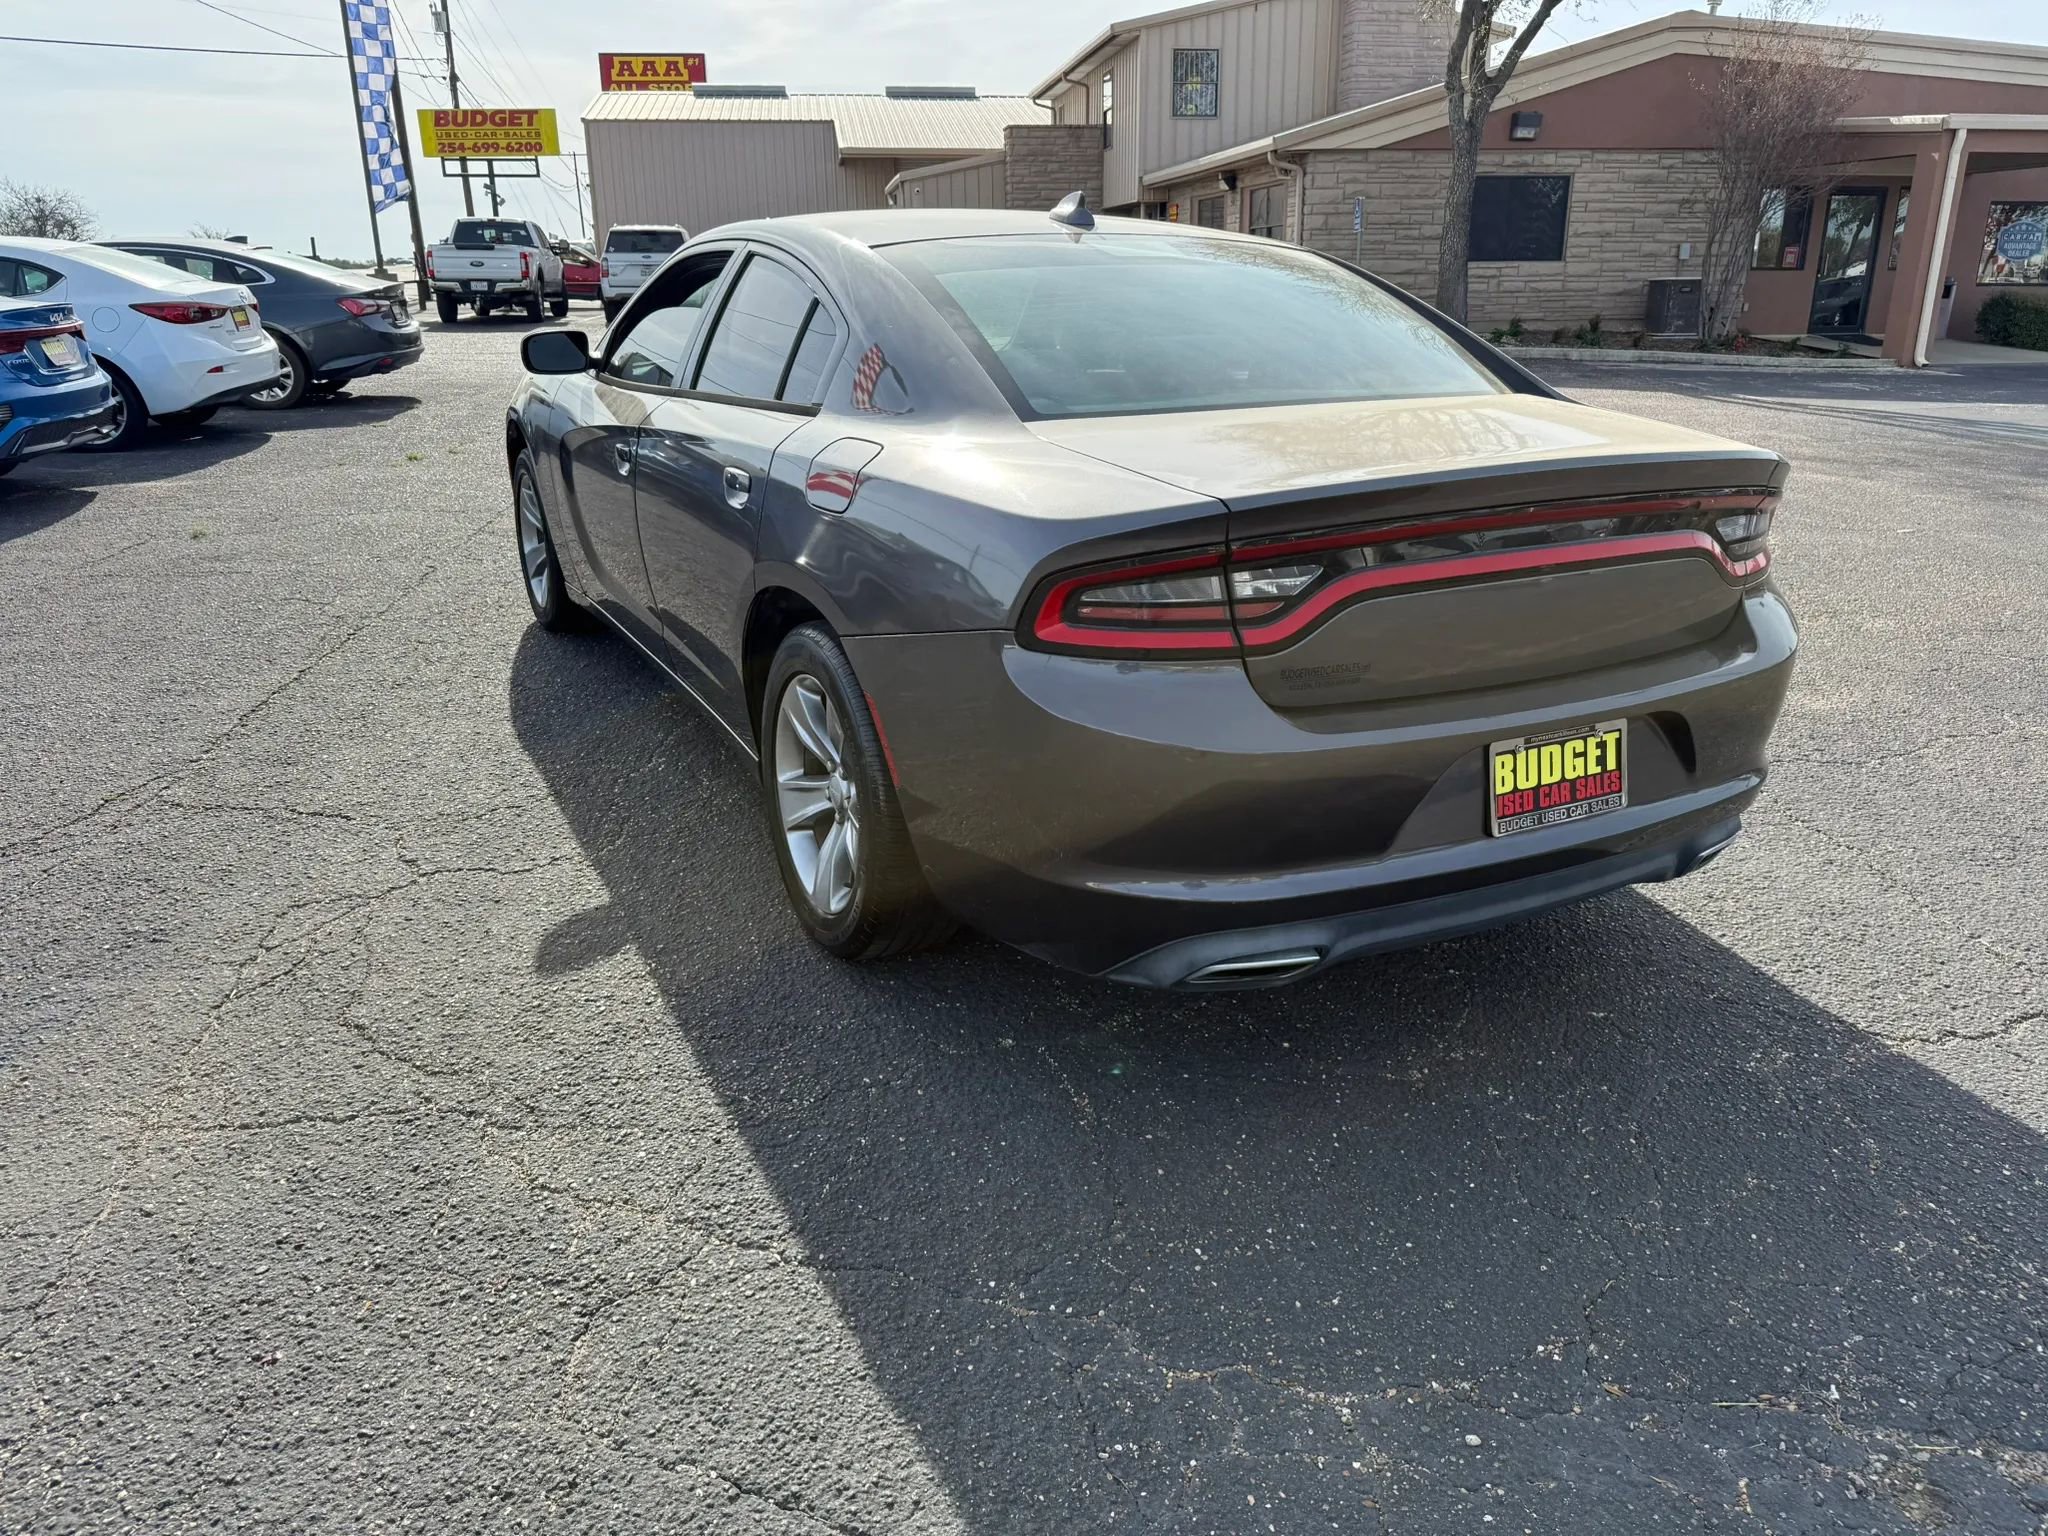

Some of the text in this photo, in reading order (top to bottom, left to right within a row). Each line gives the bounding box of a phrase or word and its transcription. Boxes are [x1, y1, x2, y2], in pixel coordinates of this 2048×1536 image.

[616, 57, 700, 77] AAA #1
[434, 110, 538, 127] BUDGET
[437, 142, 543, 153] 254-699-6200
[1495, 731, 1620, 795] BUDGET
[1539, 781, 1571, 808] CAR
[1576, 770, 1621, 800] SALES
[1500, 796, 1620, 833] BUDGET USED CAR SALES
